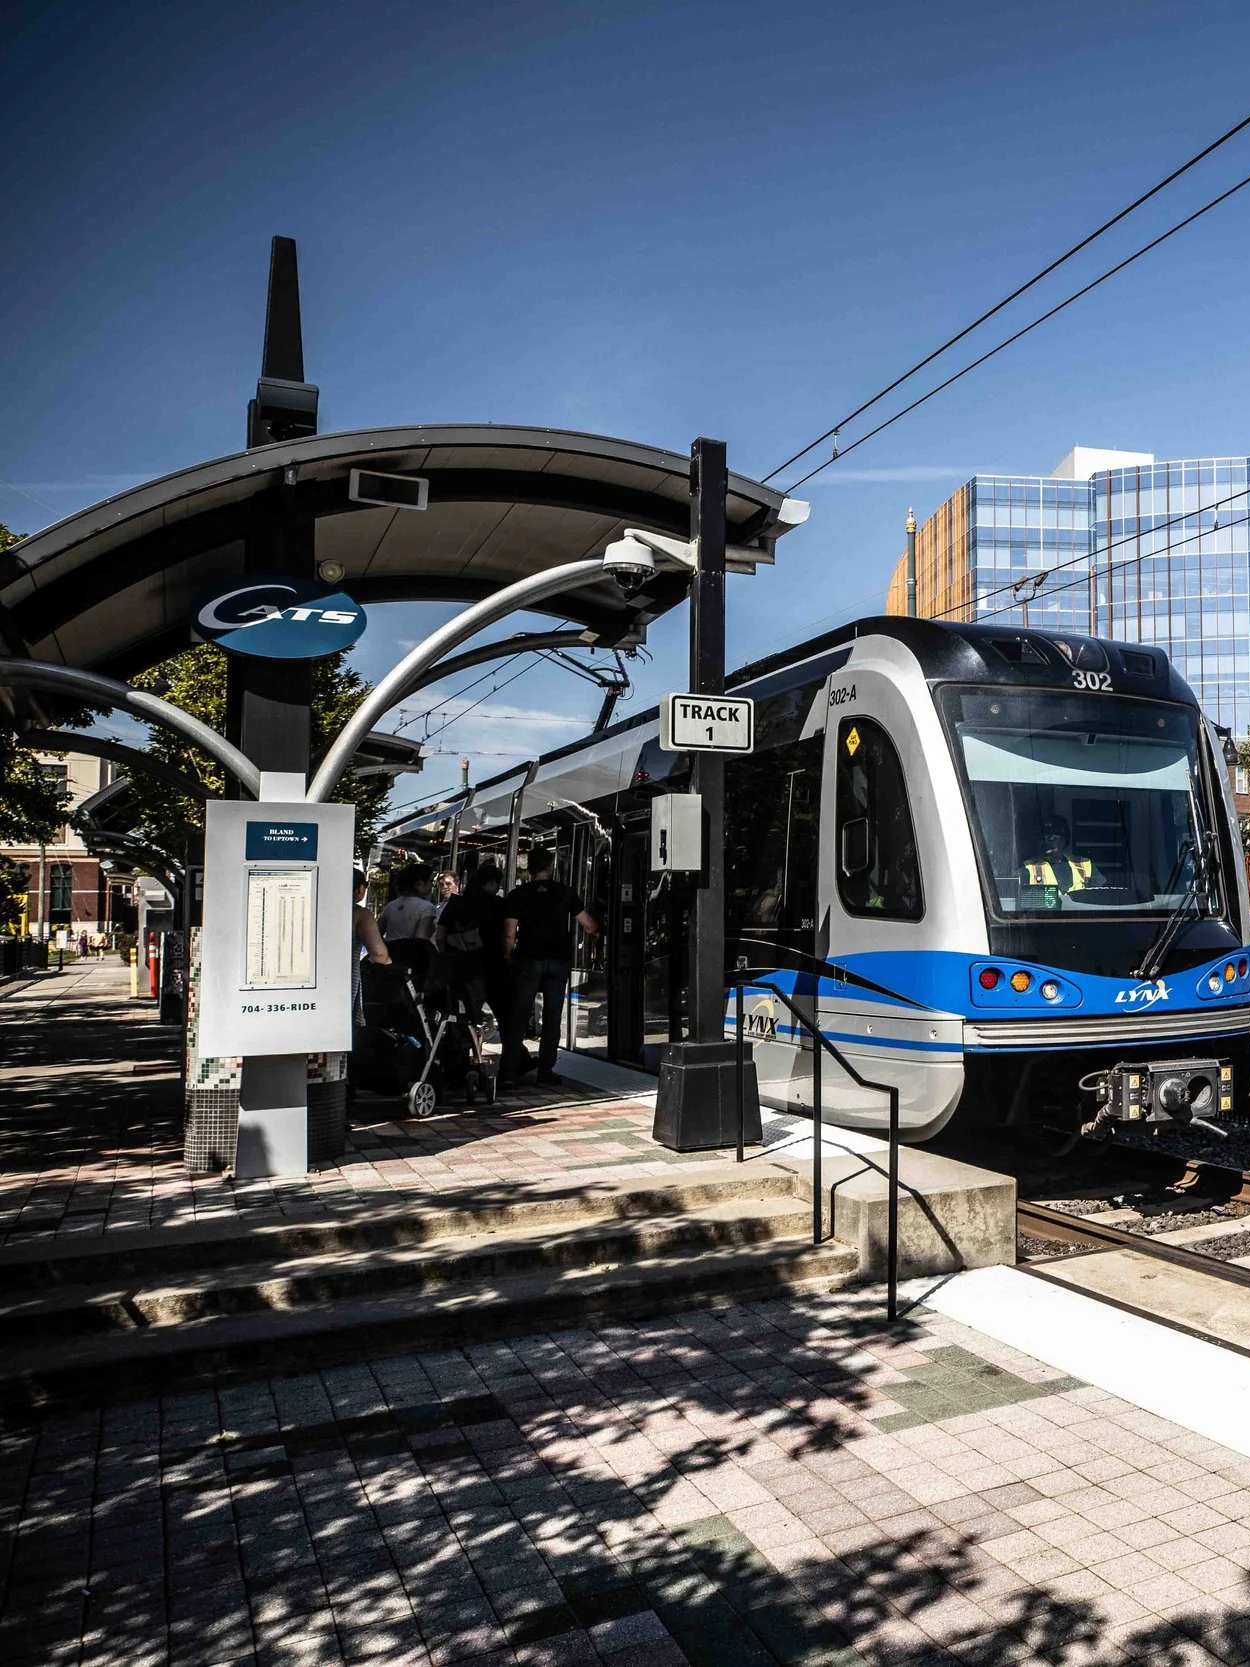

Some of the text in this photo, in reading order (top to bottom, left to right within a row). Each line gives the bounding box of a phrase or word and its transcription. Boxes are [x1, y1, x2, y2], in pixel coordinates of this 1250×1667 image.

[198, 584, 357, 629] CATS
[1072, 670, 1113, 691] 302
[829, 684, 857, 707] 302-A
[680, 703, 740, 722] TRACK
[705, 726, 714, 742] 1
[269, 828, 294, 836] BLAND
[1114, 984, 1174, 1004] LYNX
